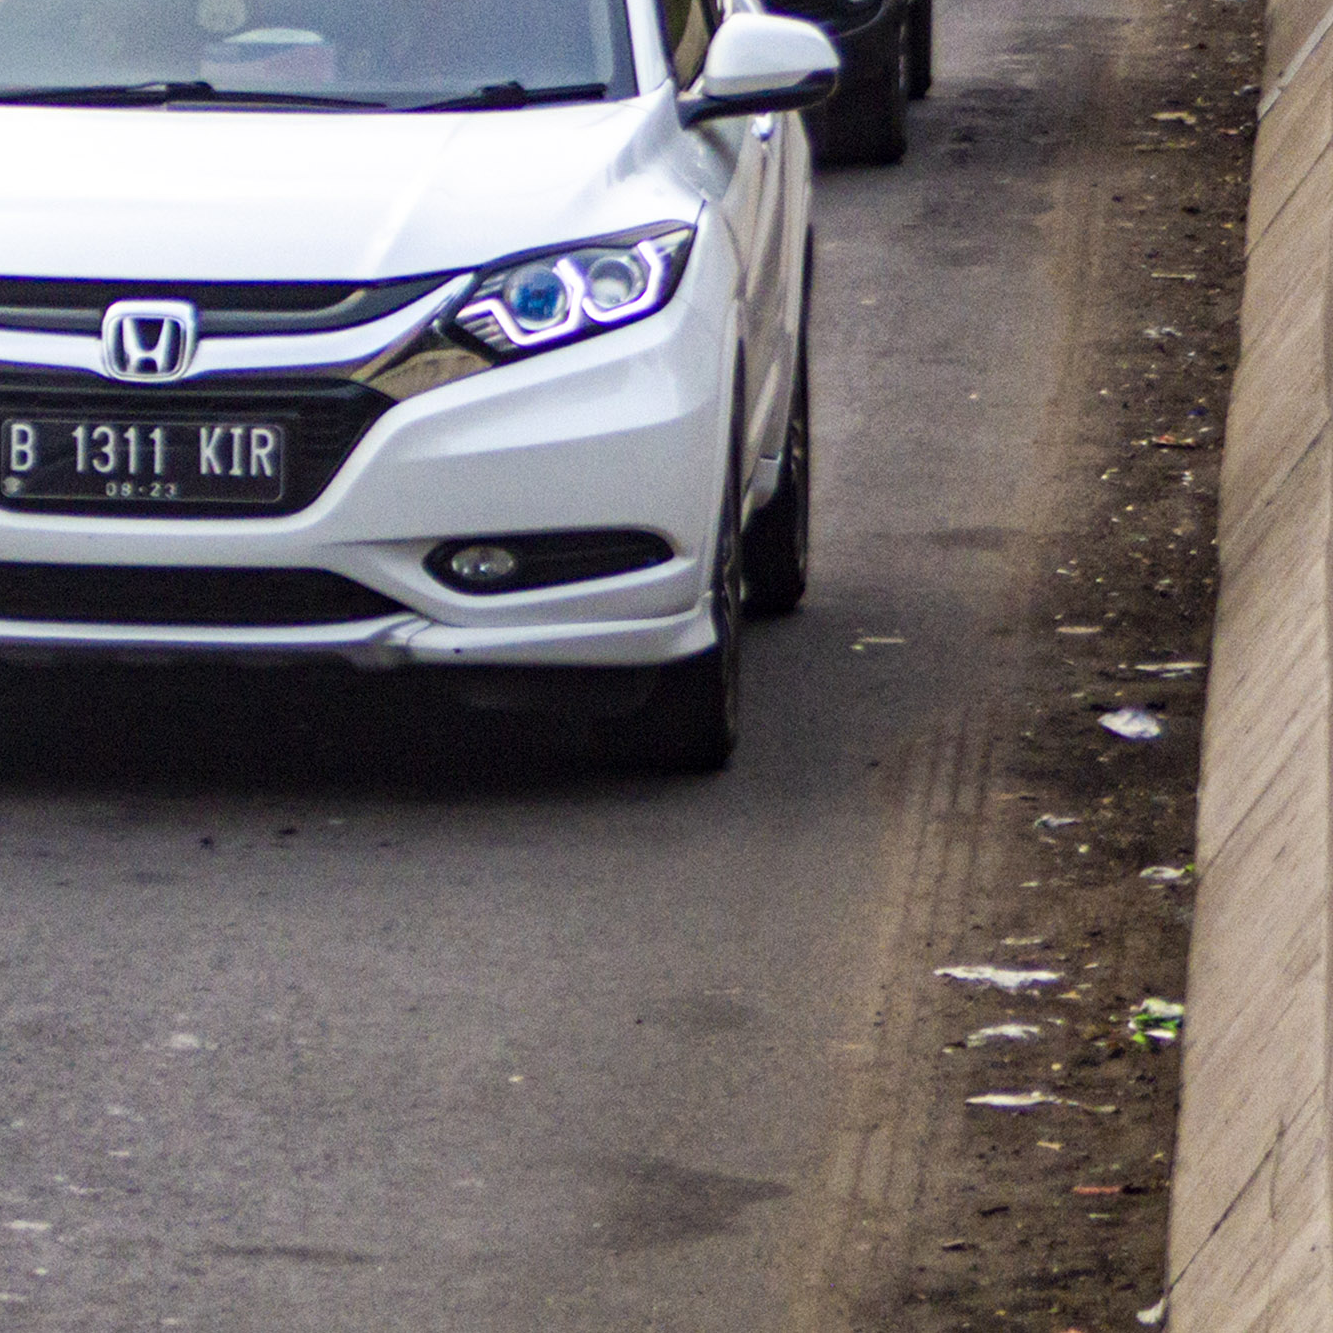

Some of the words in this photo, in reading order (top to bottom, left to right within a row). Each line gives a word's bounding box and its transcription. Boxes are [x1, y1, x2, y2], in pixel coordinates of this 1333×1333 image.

[10, 423, 34, 472] B
[72, 425, 164, 474] 1311
[199, 426, 275, 477] KIR
